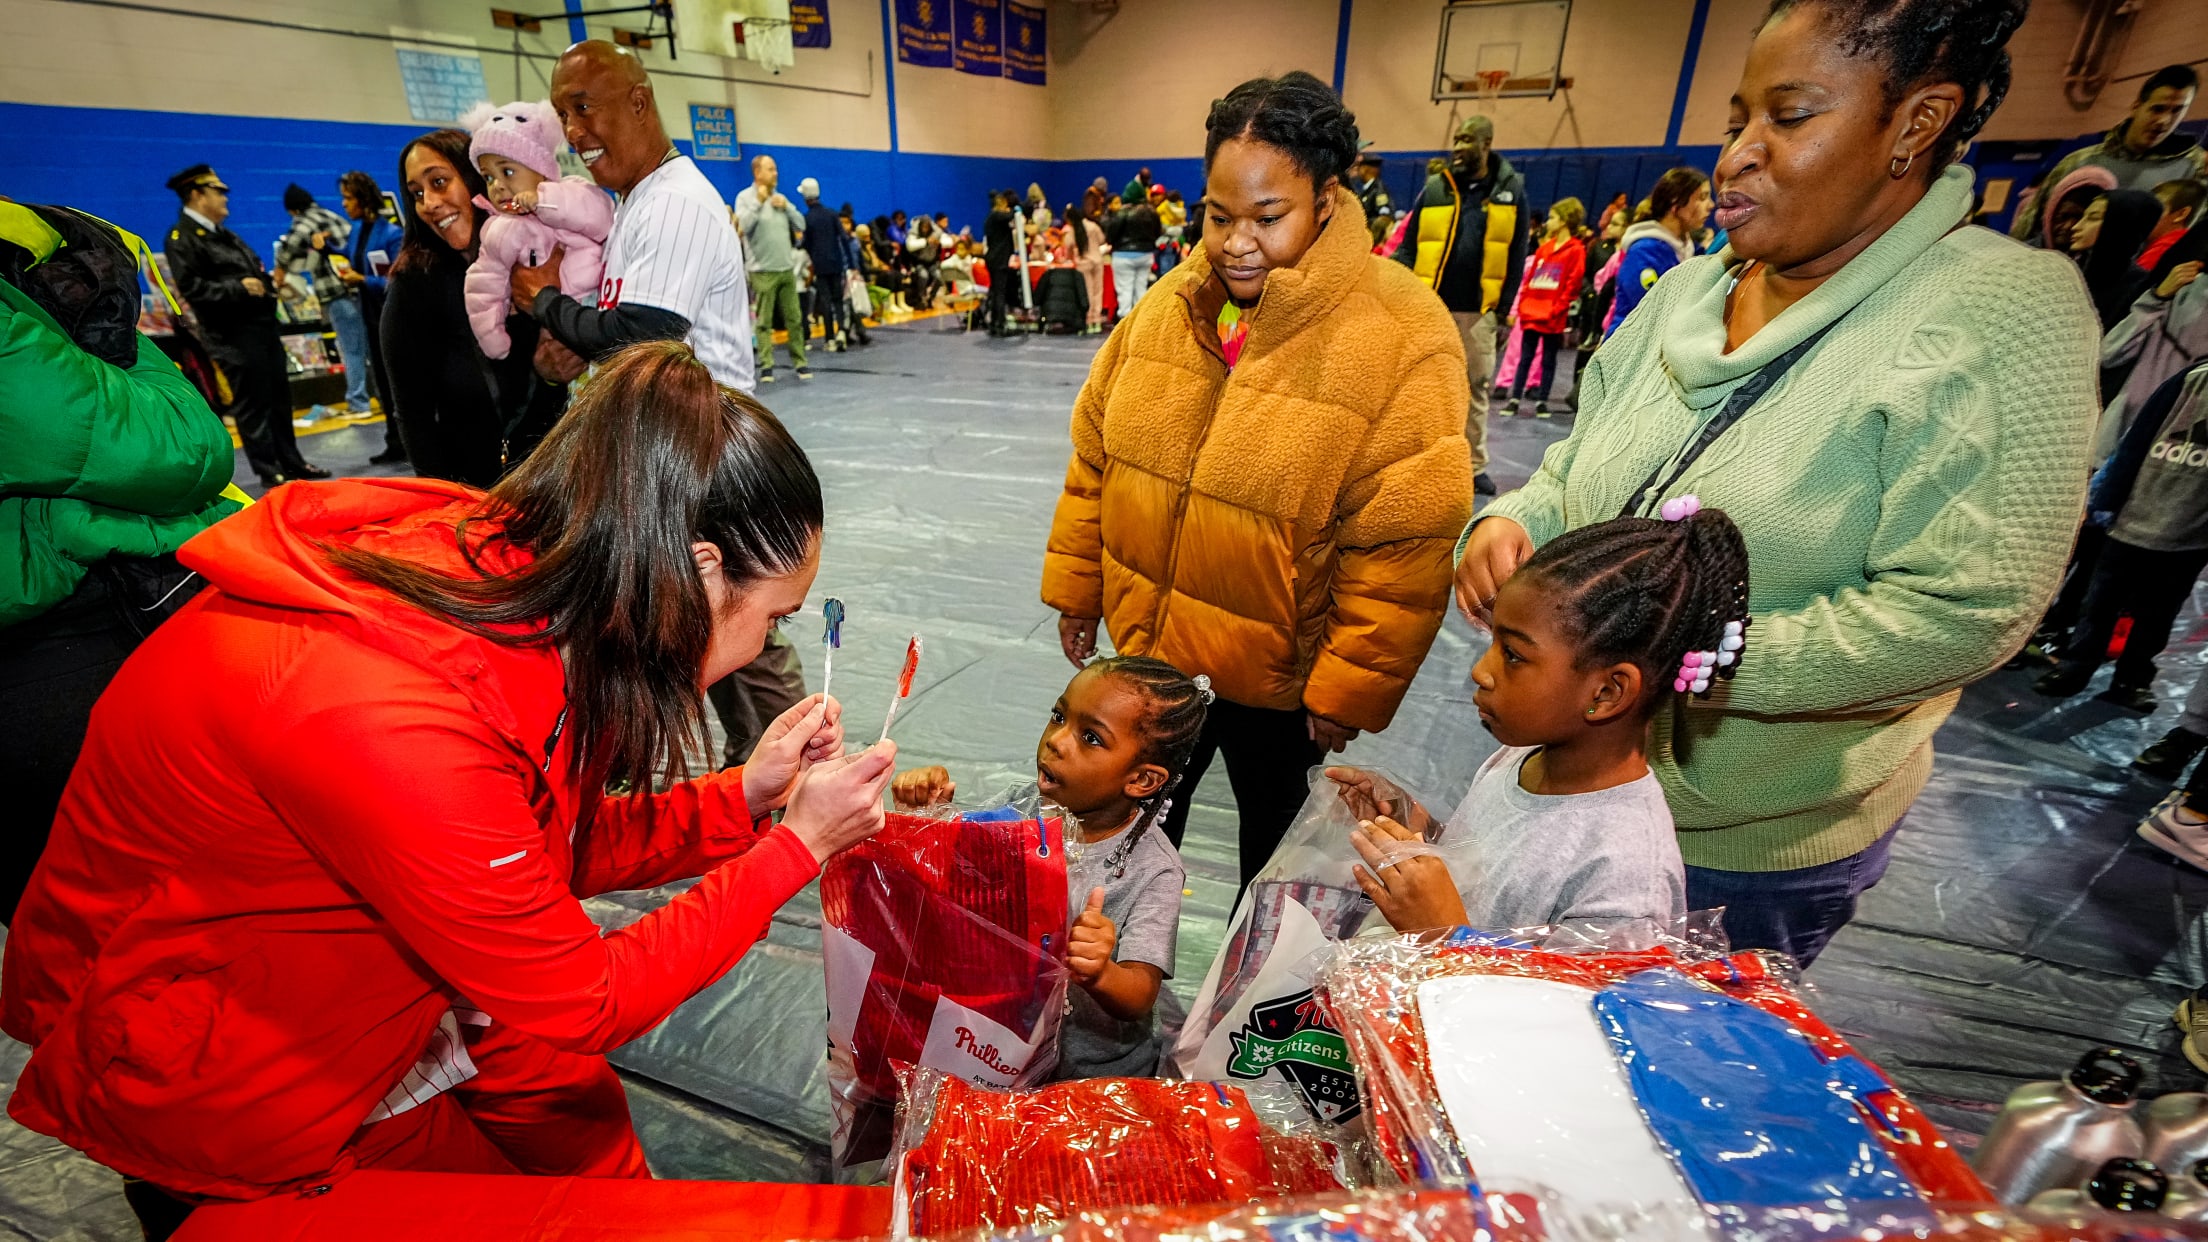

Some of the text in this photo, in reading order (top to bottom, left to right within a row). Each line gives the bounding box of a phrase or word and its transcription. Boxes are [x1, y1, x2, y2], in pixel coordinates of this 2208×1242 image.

[698, 107, 726, 119] POLICE
[695, 120, 733, 133] ATHLETIC
[699, 134, 731, 146] LEAGUE
[1277, 1039, 1342, 1061] Citizens
[1320, 1074, 1354, 1090] EST.
[1310, 1083, 1356, 1101] 2004
